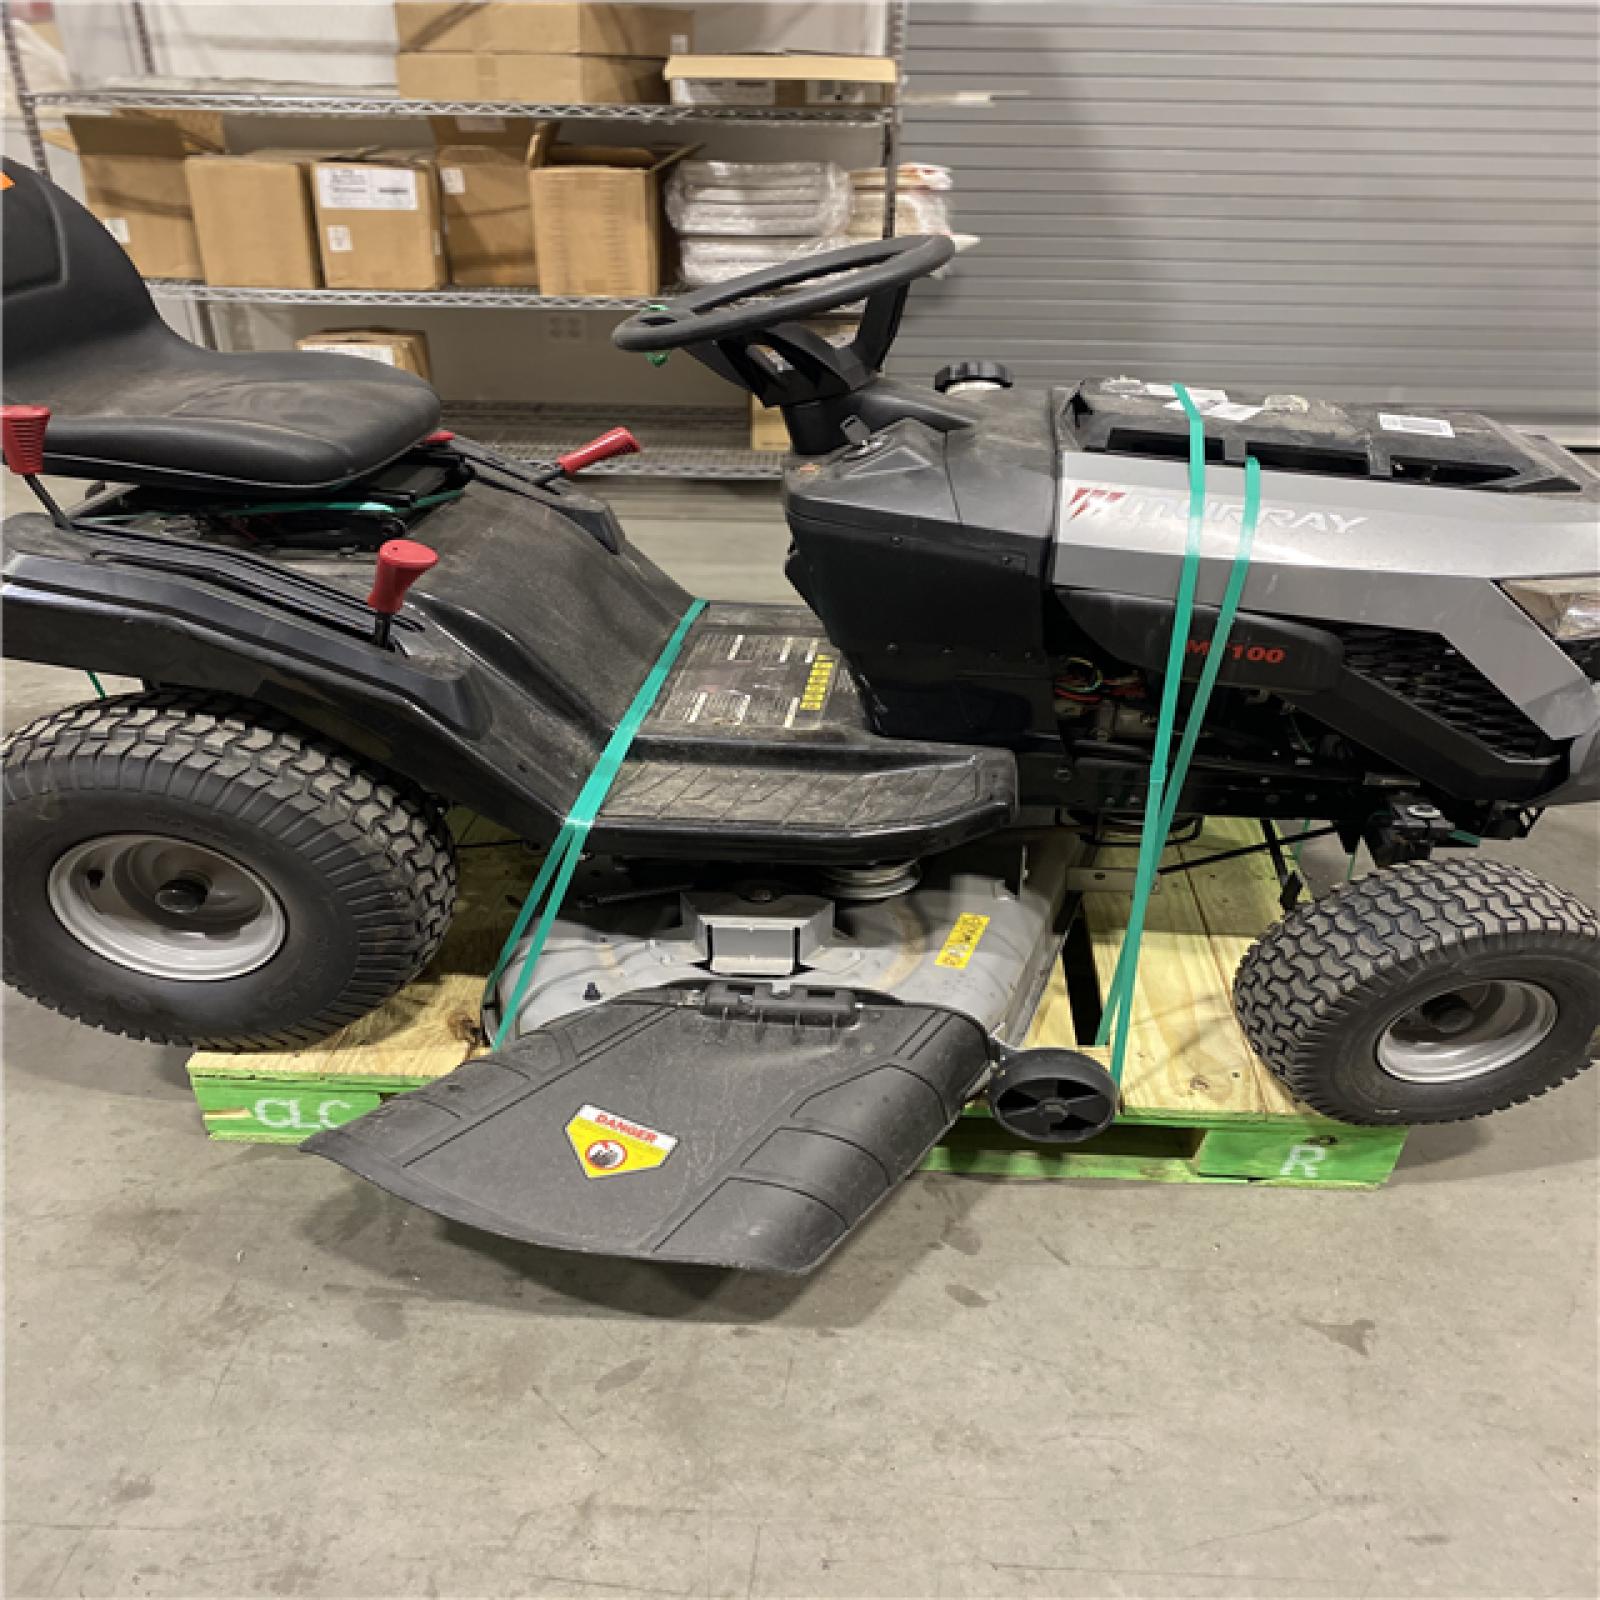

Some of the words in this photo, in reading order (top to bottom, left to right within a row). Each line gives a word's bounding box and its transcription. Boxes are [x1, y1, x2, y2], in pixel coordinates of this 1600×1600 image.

[1186, 640, 1285, 663] M100
[595, 1113, 658, 1143] DANGER
[1279, 1144, 1325, 1178] R
